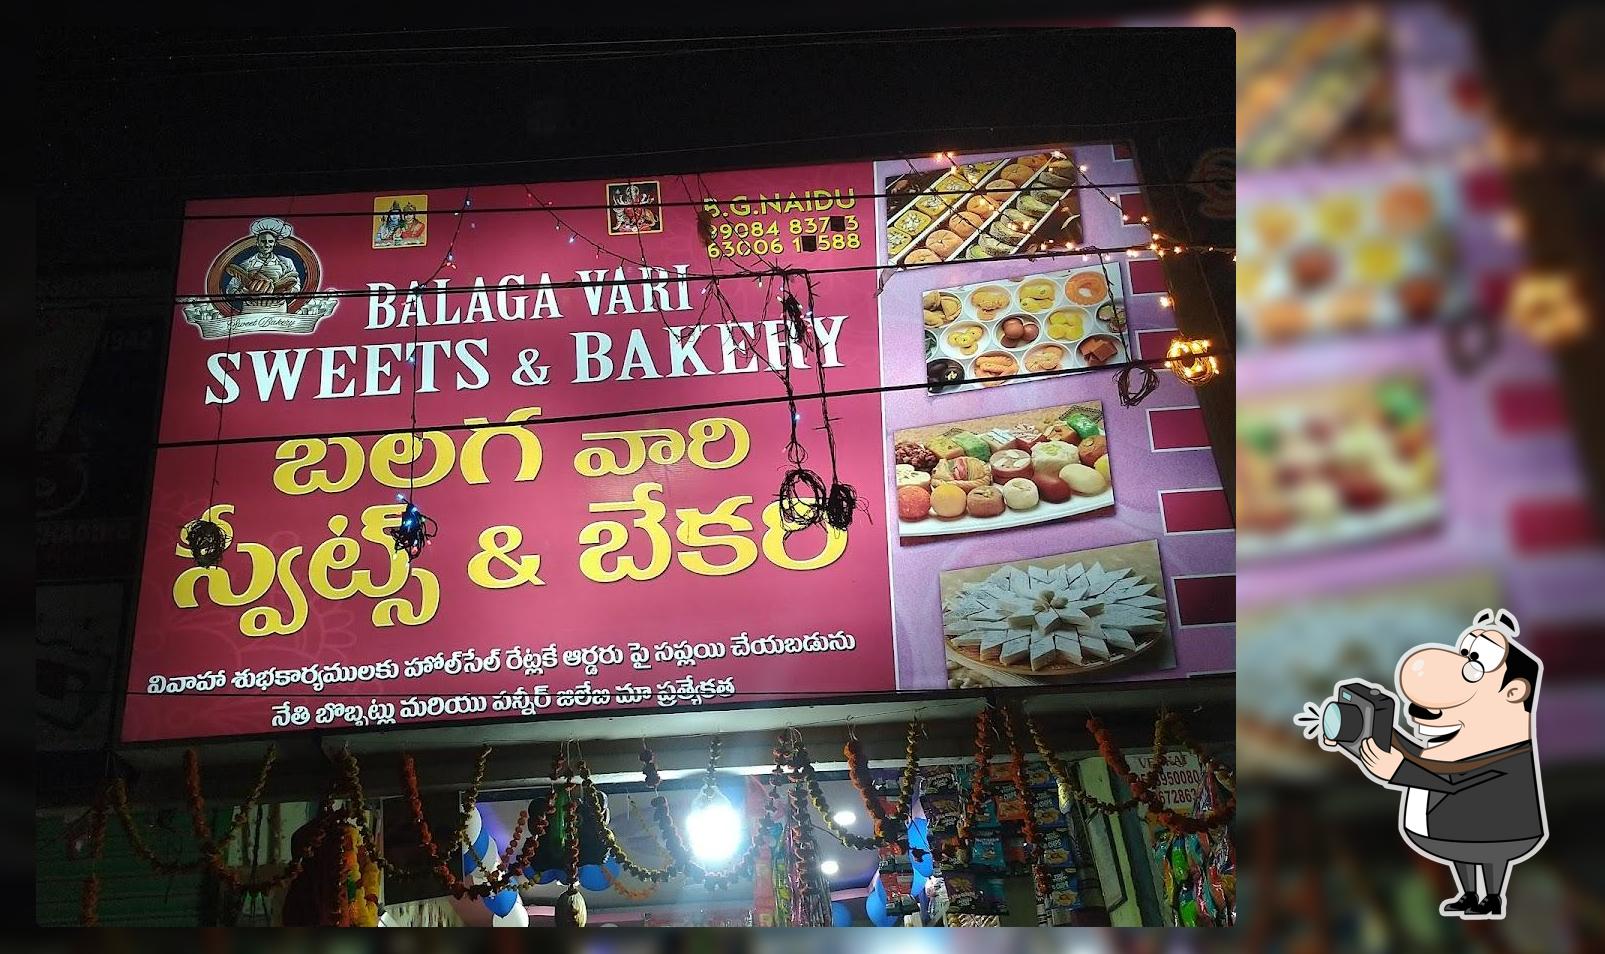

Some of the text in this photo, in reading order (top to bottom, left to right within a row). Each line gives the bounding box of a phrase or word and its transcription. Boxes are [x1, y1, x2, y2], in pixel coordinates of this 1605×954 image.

[707, 233, 861, 259] 63006 1588
[789, 215, 859, 235] 8373
[365, 264, 695, 330] BALAGA VARI
[204, 315, 849, 406] SWEETS & BAKERY
[273, 407, 750, 495] బలగ వారి
[467, 525, 547, 589] &
[230, 660, 400, 692] శుభకార్యములకు
[730, 632, 856, 658] చేయబడును
[272, 701, 311, 728] నేతి
[400, 691, 487, 719] మరియు
[657, 675, 736, 706] ప్రత్యేకత
